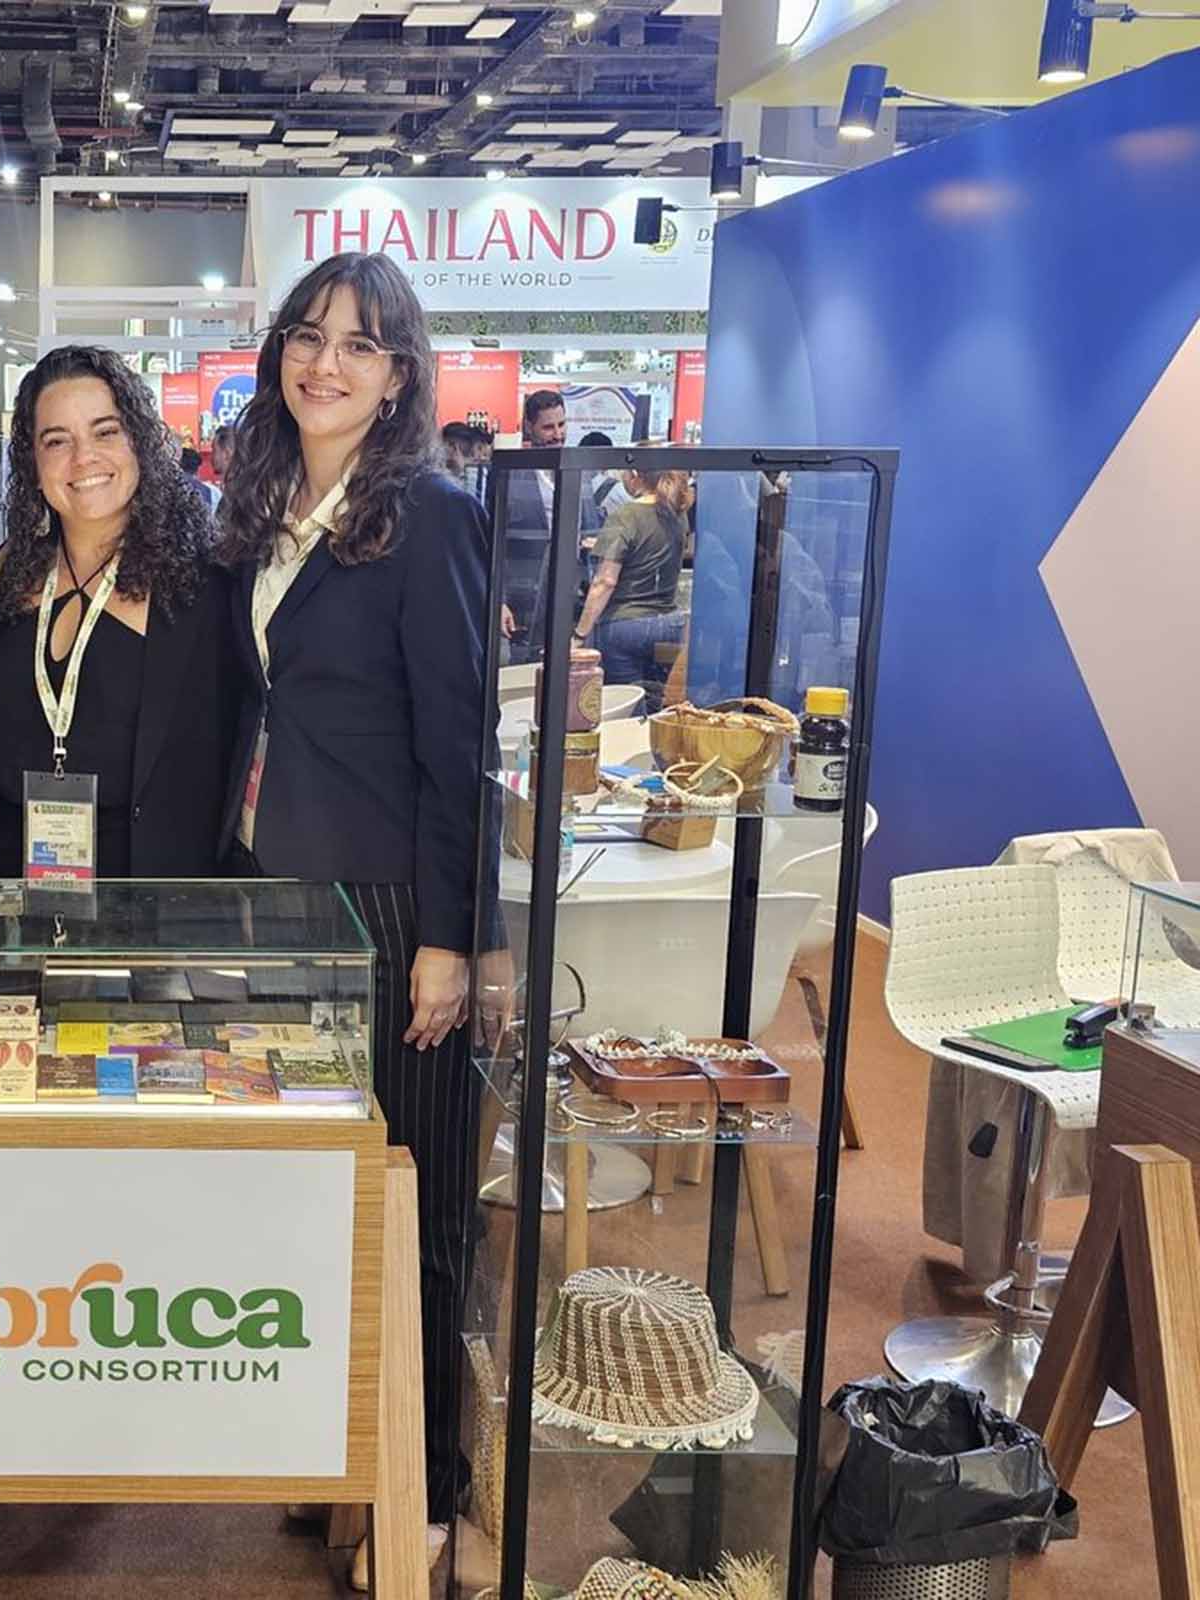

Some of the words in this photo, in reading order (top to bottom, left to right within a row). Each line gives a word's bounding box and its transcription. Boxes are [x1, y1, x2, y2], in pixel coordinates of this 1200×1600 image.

[294, 208, 617, 261] THAILAND
[423, 272, 449, 287] OF
[458, 272, 492, 286] THE
[500, 272, 572, 287] WORLD
[22, 1358, 281, 1382] CONSORTIUM
